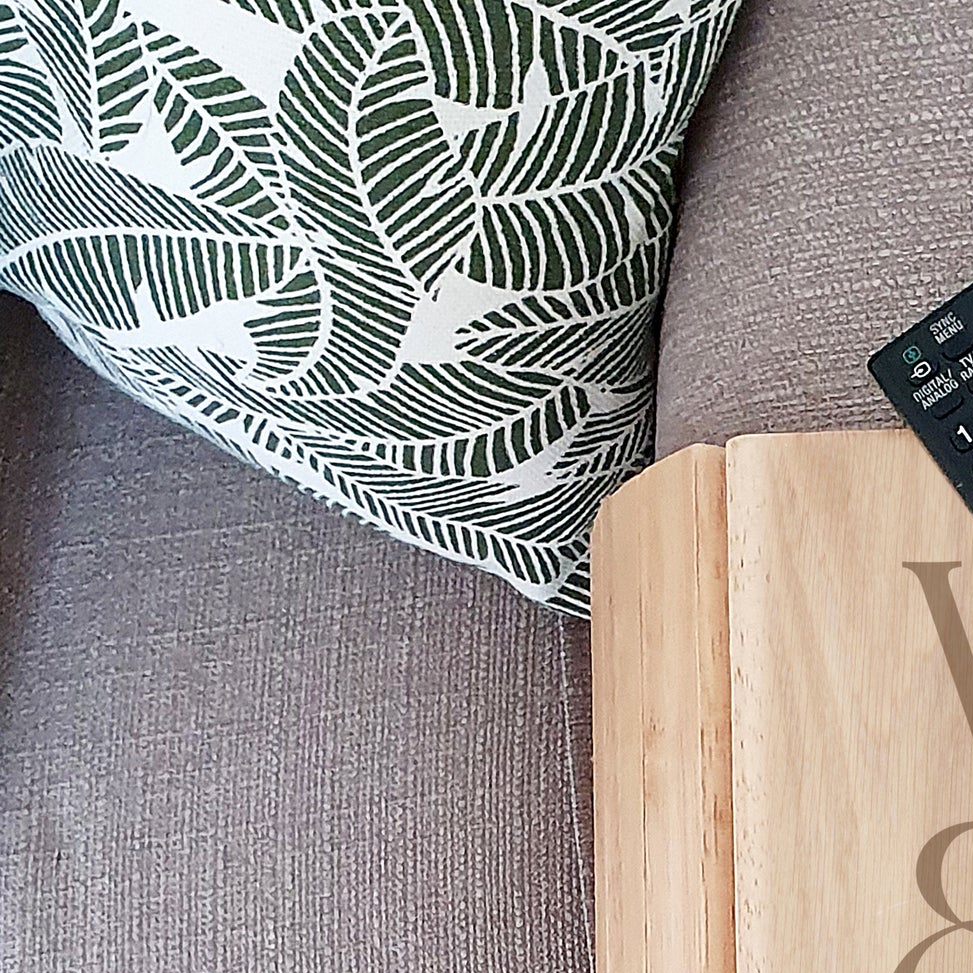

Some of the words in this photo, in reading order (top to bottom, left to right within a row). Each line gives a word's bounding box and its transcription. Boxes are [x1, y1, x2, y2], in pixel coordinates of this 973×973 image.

[929, 311, 957, 335] SYNC
[934, 319, 964, 345] MENU
[920, 378, 960, 411] ANALOG
[956, 424, 973, 443] 1
